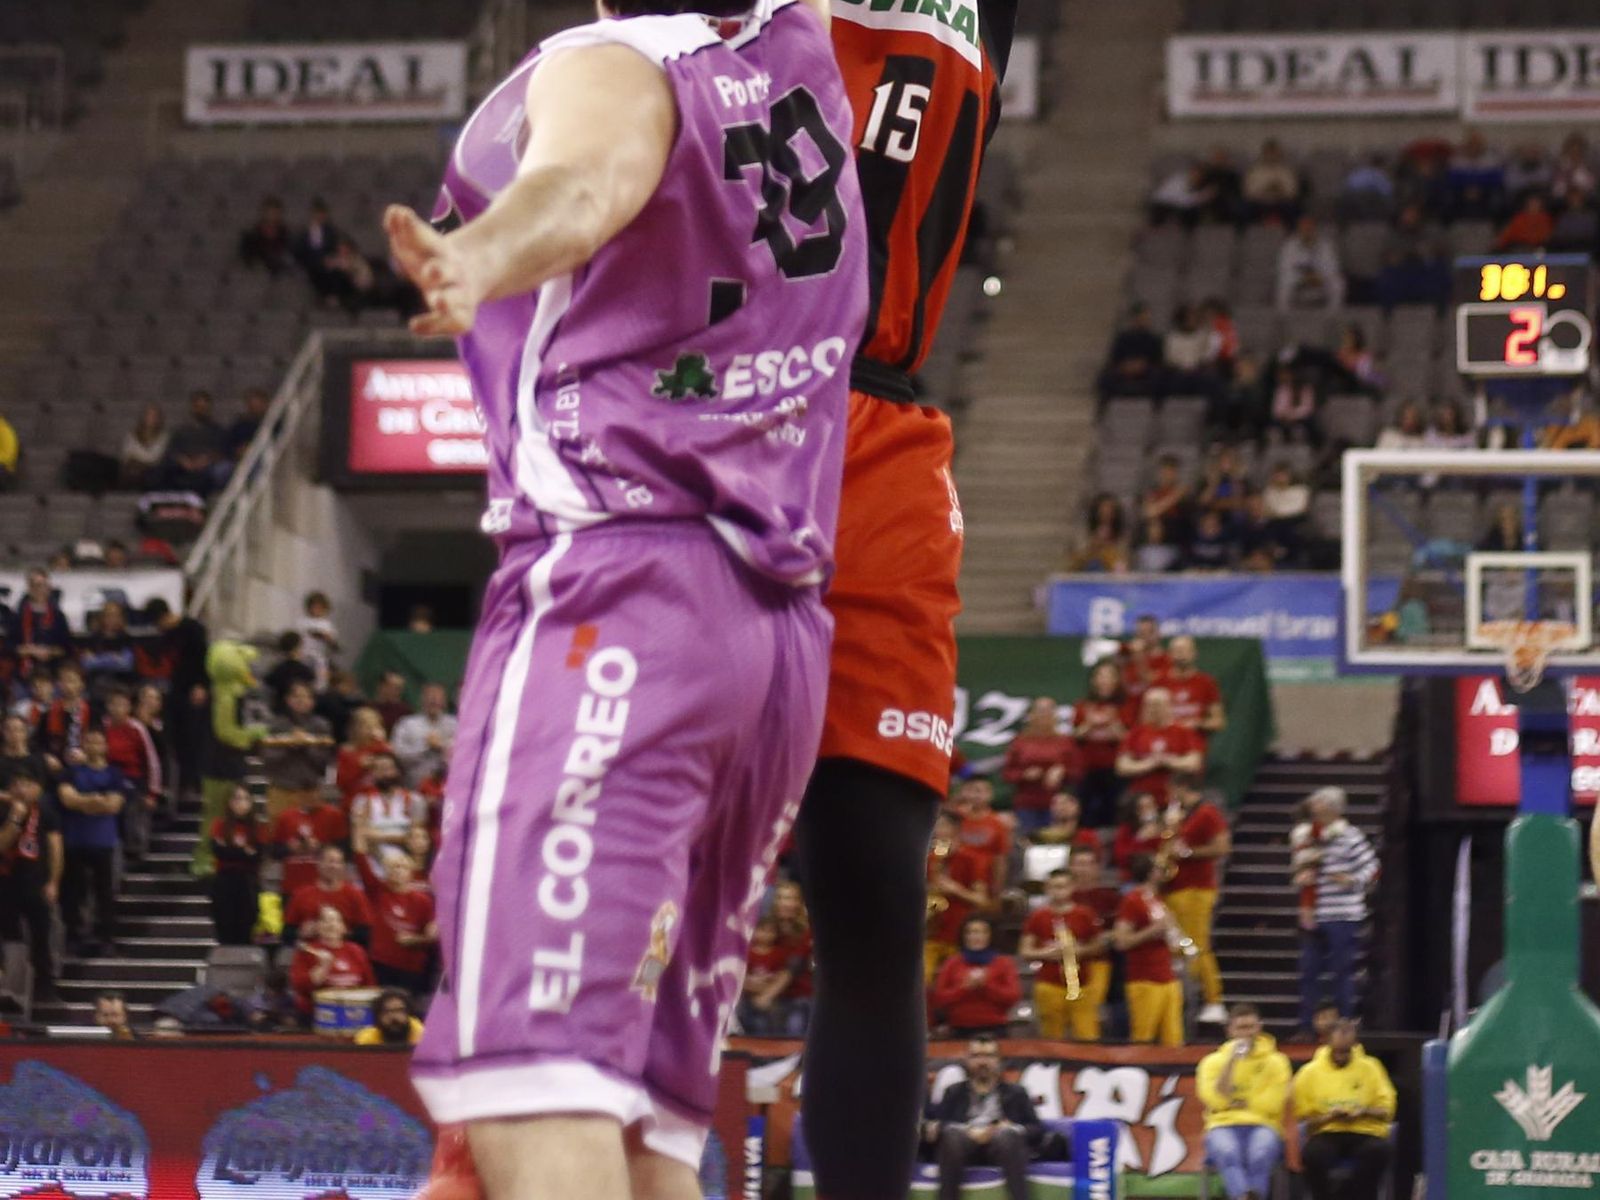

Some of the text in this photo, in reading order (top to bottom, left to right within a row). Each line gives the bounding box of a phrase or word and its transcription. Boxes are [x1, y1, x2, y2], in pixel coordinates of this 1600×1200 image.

[207, 55, 449, 101] IDEAL
[1194, 46, 1442, 94] IDEAL
[860, 80, 931, 163] 15
[1505, 306, 1542, 367] 2
[528, 646, 638, 1015] EL CORREO
